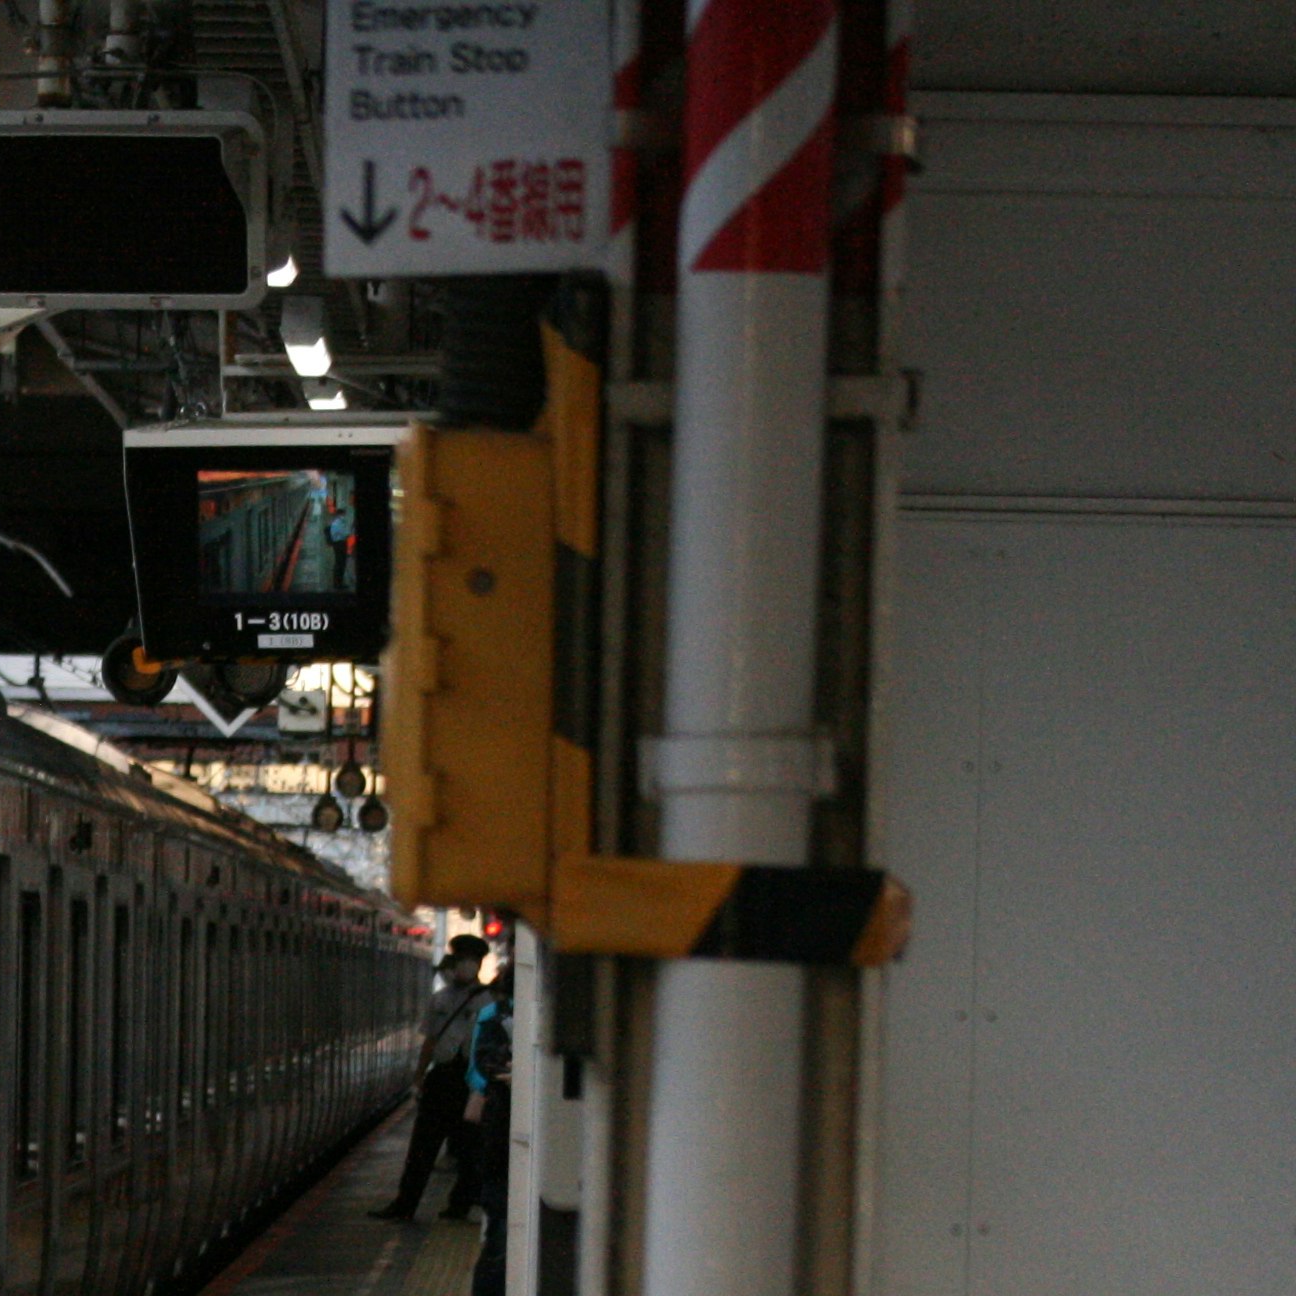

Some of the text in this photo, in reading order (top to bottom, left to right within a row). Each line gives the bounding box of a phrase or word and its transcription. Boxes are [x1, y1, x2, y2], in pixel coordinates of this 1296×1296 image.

[351, 2, 538, 32] Emergency
[353, 41, 530, 76] Train Stop
[349, 89, 465, 121] Button
